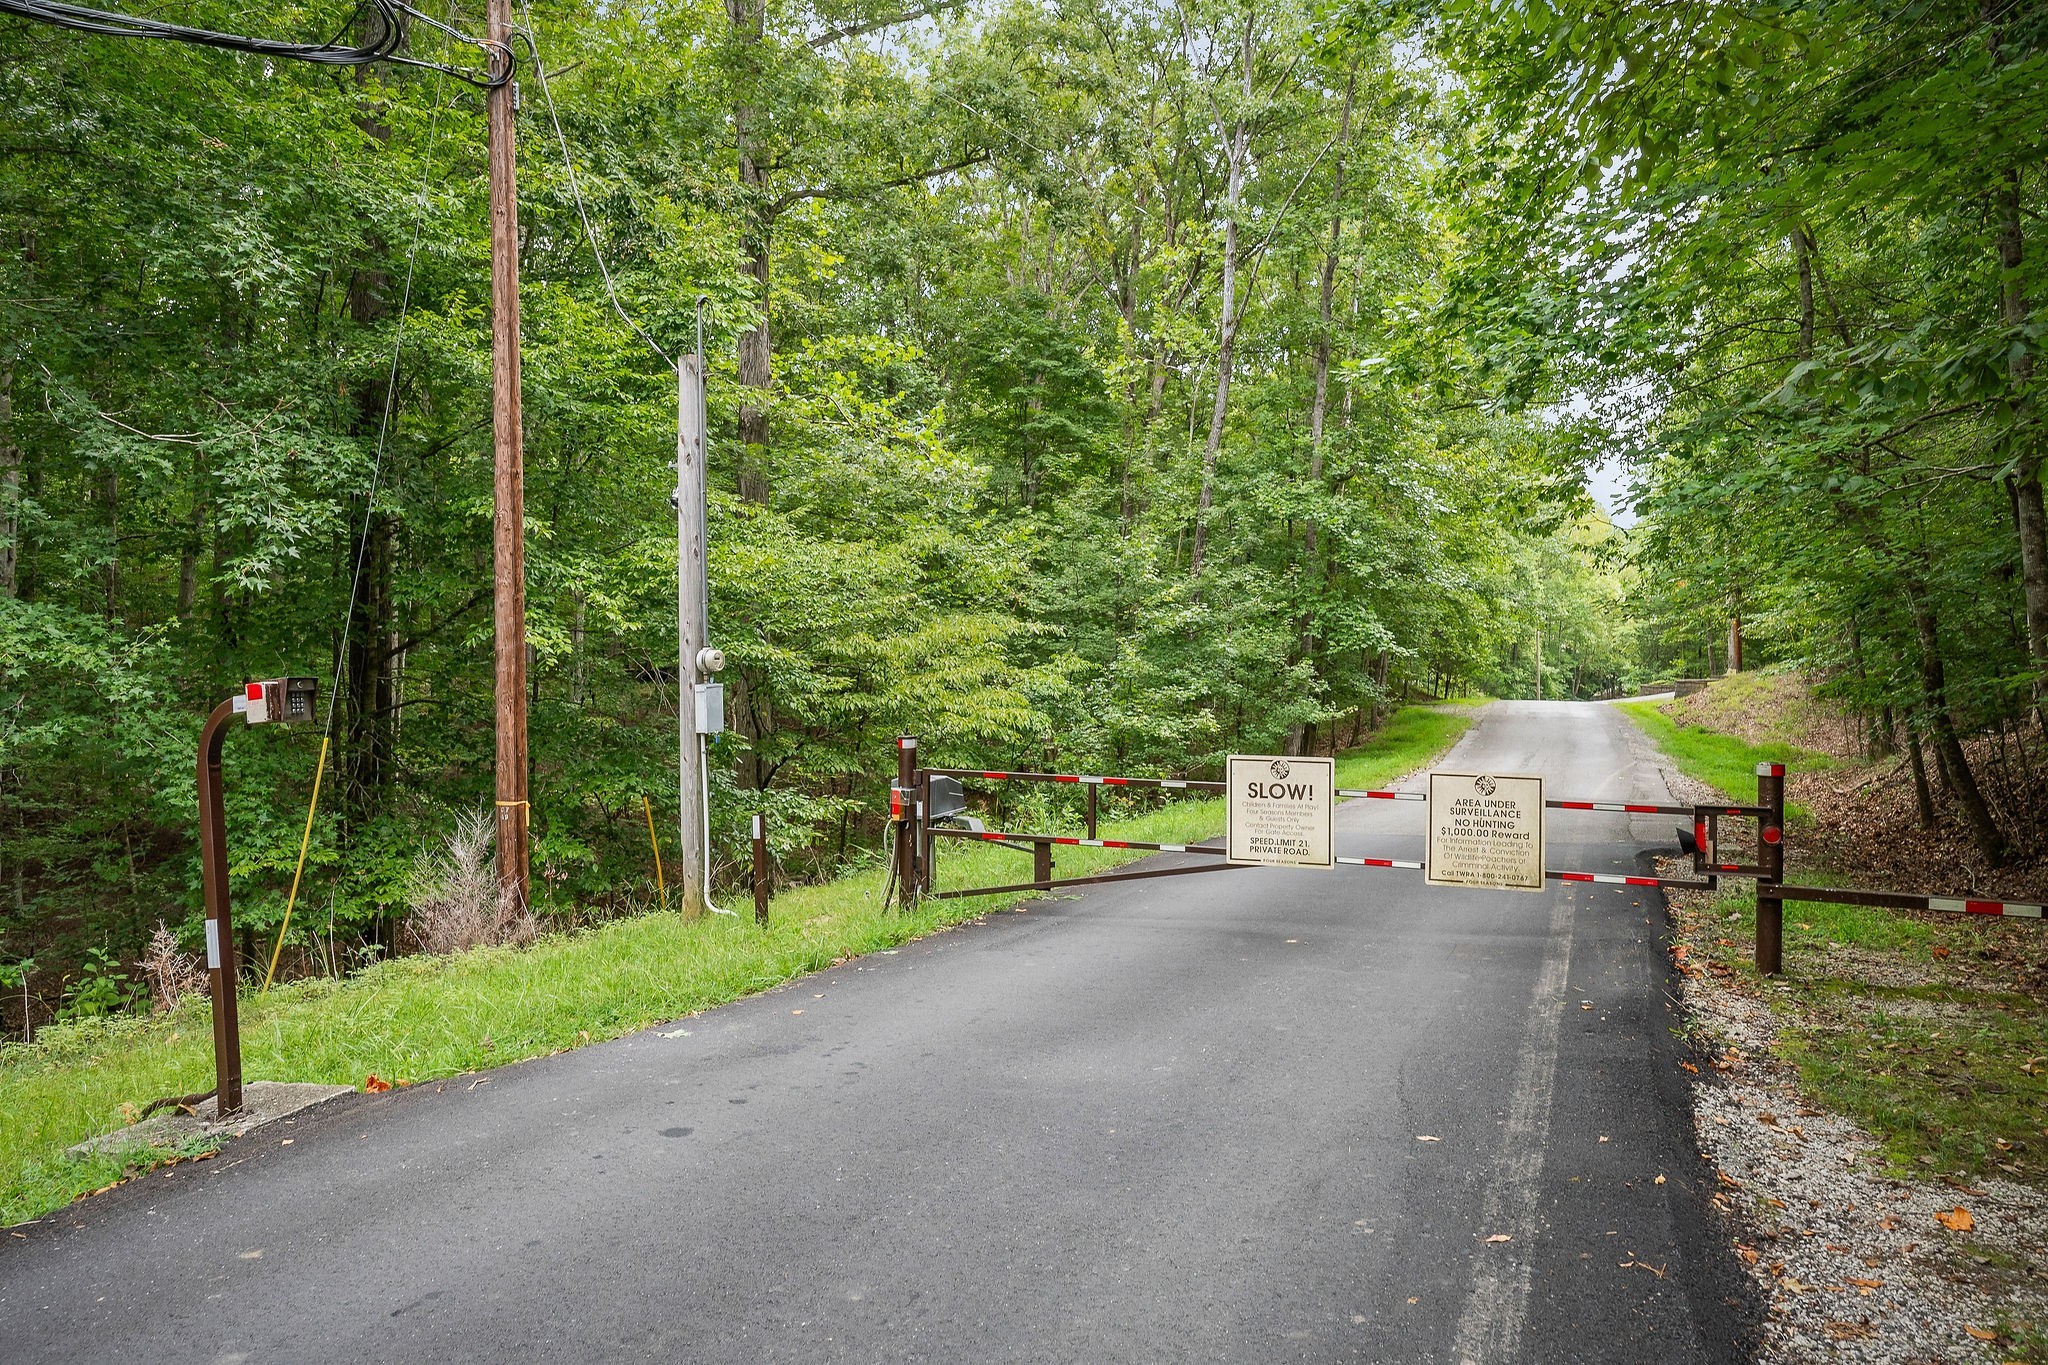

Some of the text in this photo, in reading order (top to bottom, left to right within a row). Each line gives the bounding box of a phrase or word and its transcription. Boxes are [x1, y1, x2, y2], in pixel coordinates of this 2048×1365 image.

[1248, 782, 1313, 800] SLOW!
[1455, 798, 1516, 809] AREA UNDER
[1450, 807, 1521, 819] SURVEILLANCE
[1473, 820, 1515, 830] HUNTING
[1441, 826, 1530, 840] $1,000.00 Reward
[1450, 838, 1491, 846] Information
[1493, 840, 1523, 849] Leading
[1250, 846, 1310, 856] PRIVATE ROAD.
[1490, 848, 1530, 856] Conviction
[1452, 861, 1488, 869] Criminal
